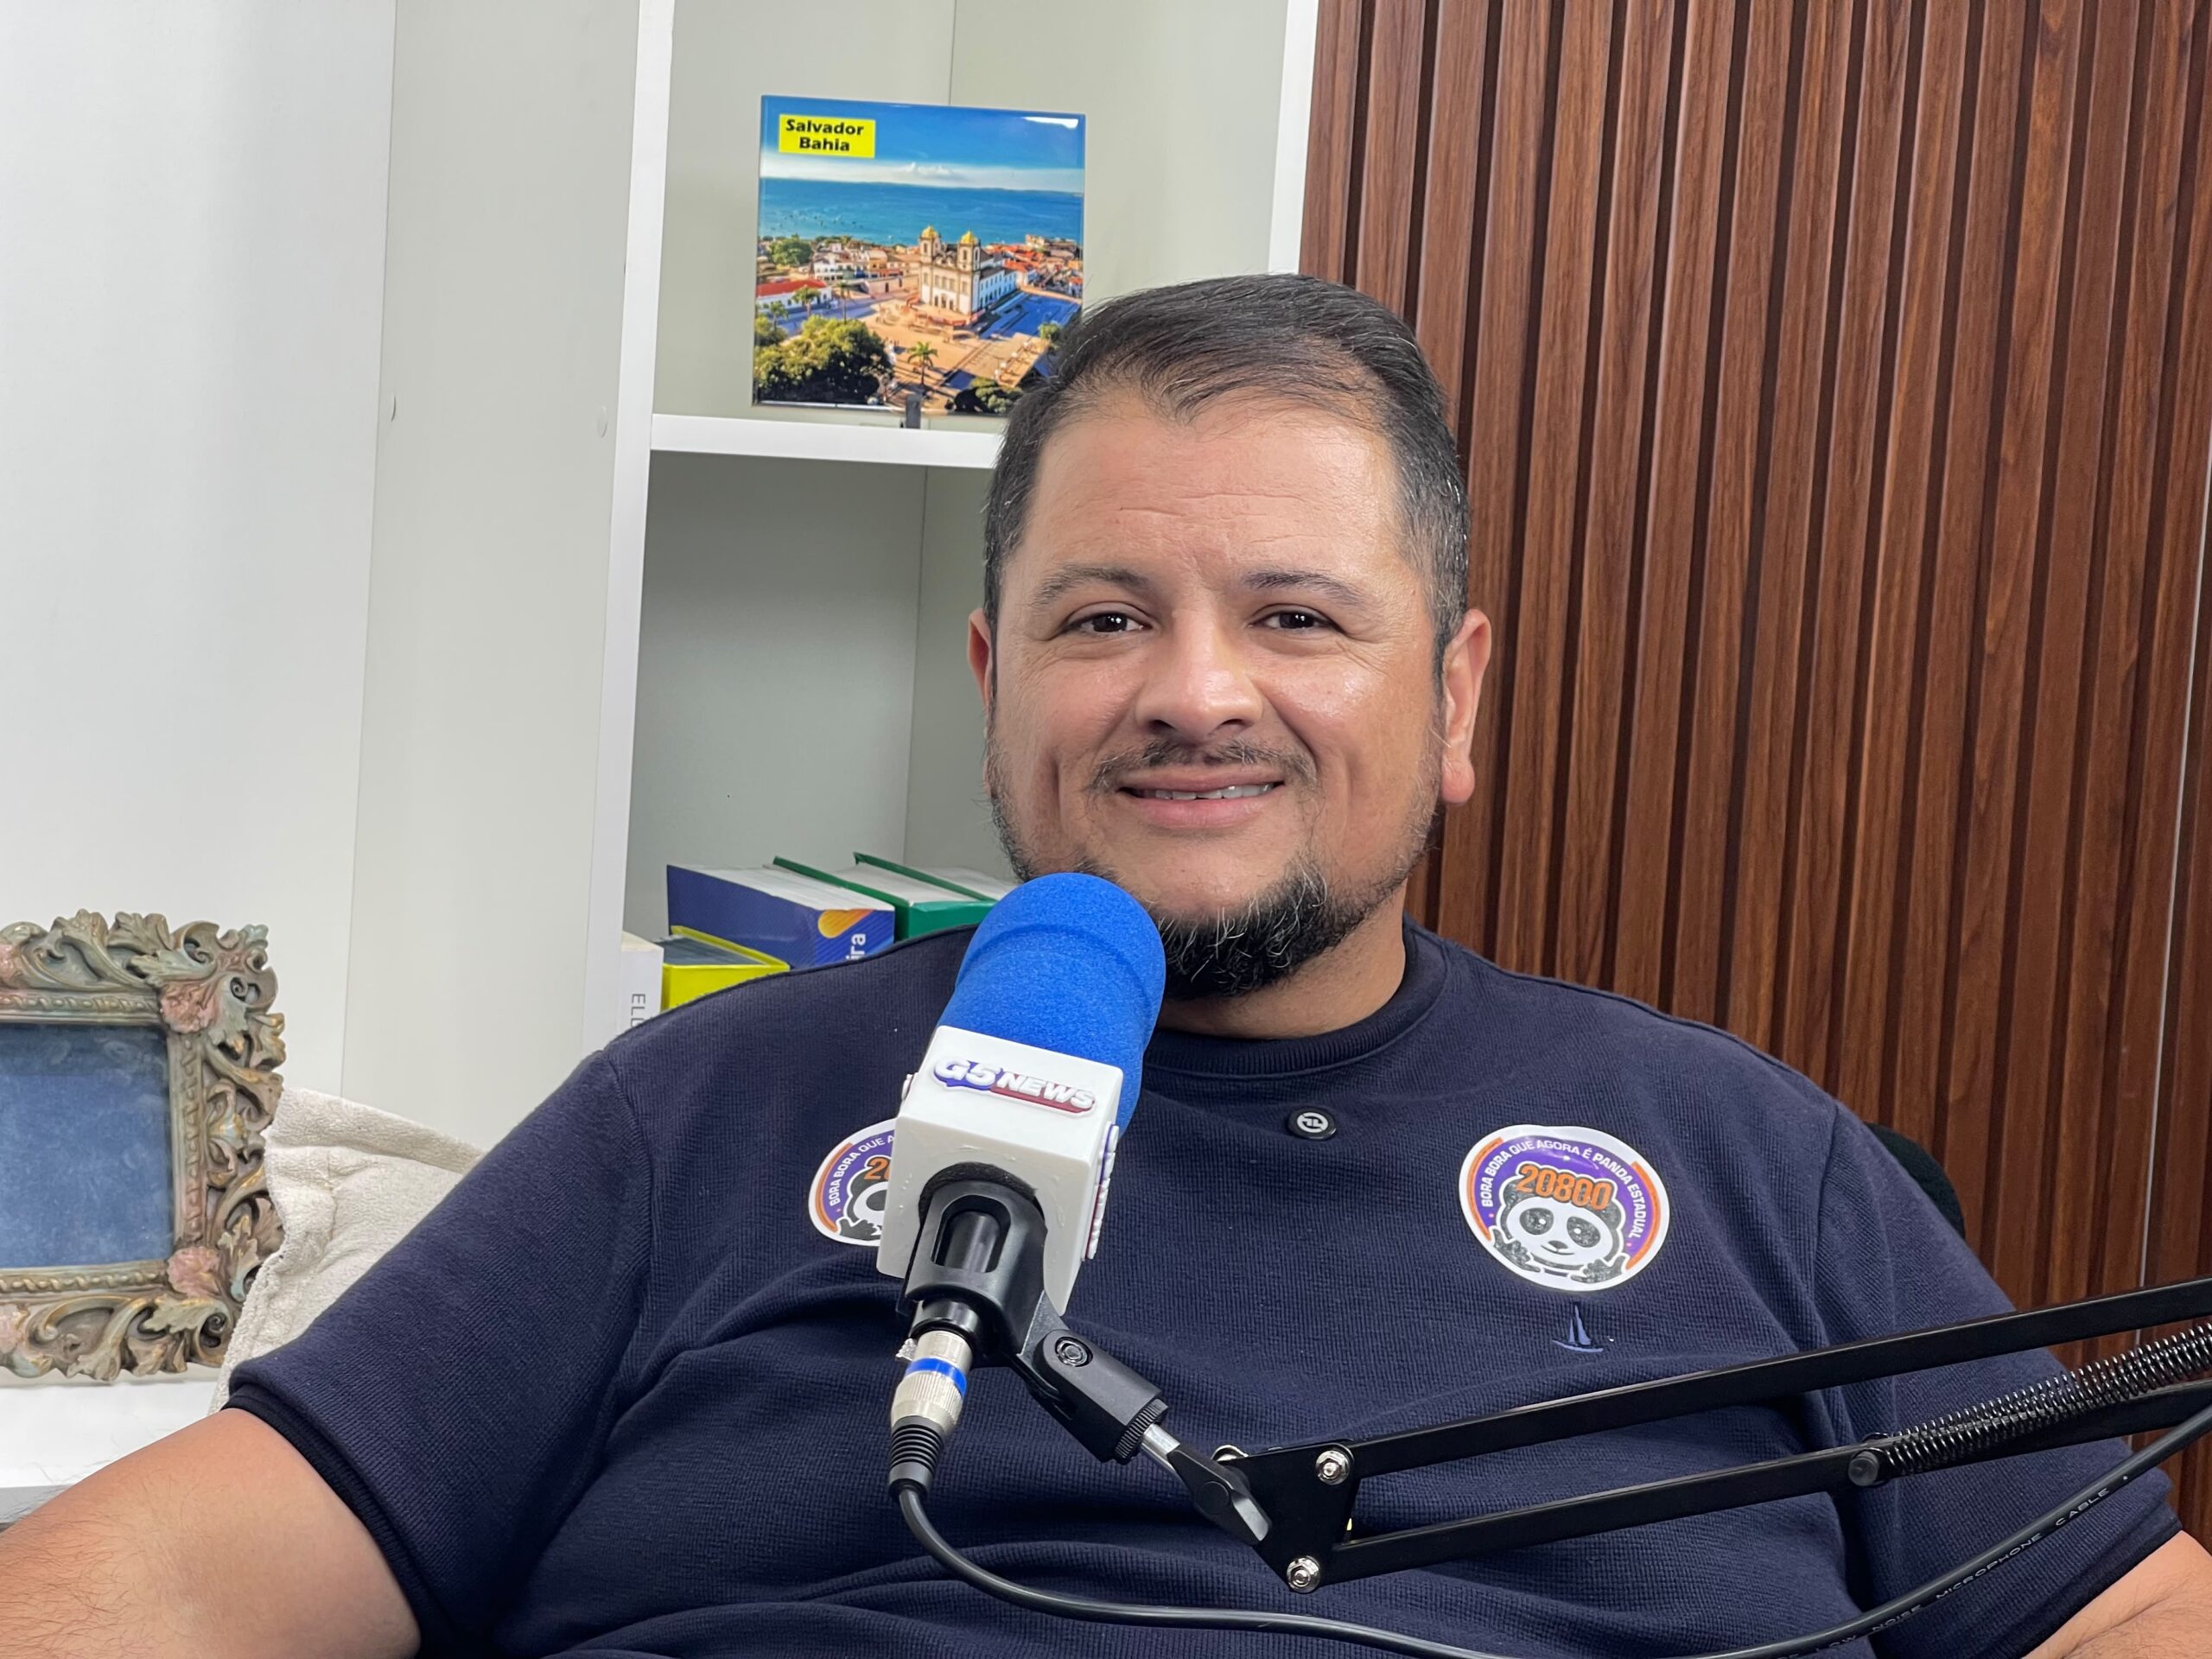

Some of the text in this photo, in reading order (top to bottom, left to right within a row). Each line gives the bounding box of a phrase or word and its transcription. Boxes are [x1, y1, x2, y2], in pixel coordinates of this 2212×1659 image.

[785, 118, 865, 136] Salvador
[799, 136, 850, 152] Bahia
[996, 1071, 1096, 1110] NEWS
[858, 1137, 886, 1153] QUE
[832, 1152, 861, 1178] BORA
[828, 1178, 842, 1207] BORA
[1479, 1139, 1647, 1238] BORA BORA QUE AGORA É PANDA ESTADUAL
[1515, 1163, 1613, 1211] 20800
[1935, 1532, 2044, 1599] MICROPHONE
[2055, 1486, 2111, 1527] CABLE
